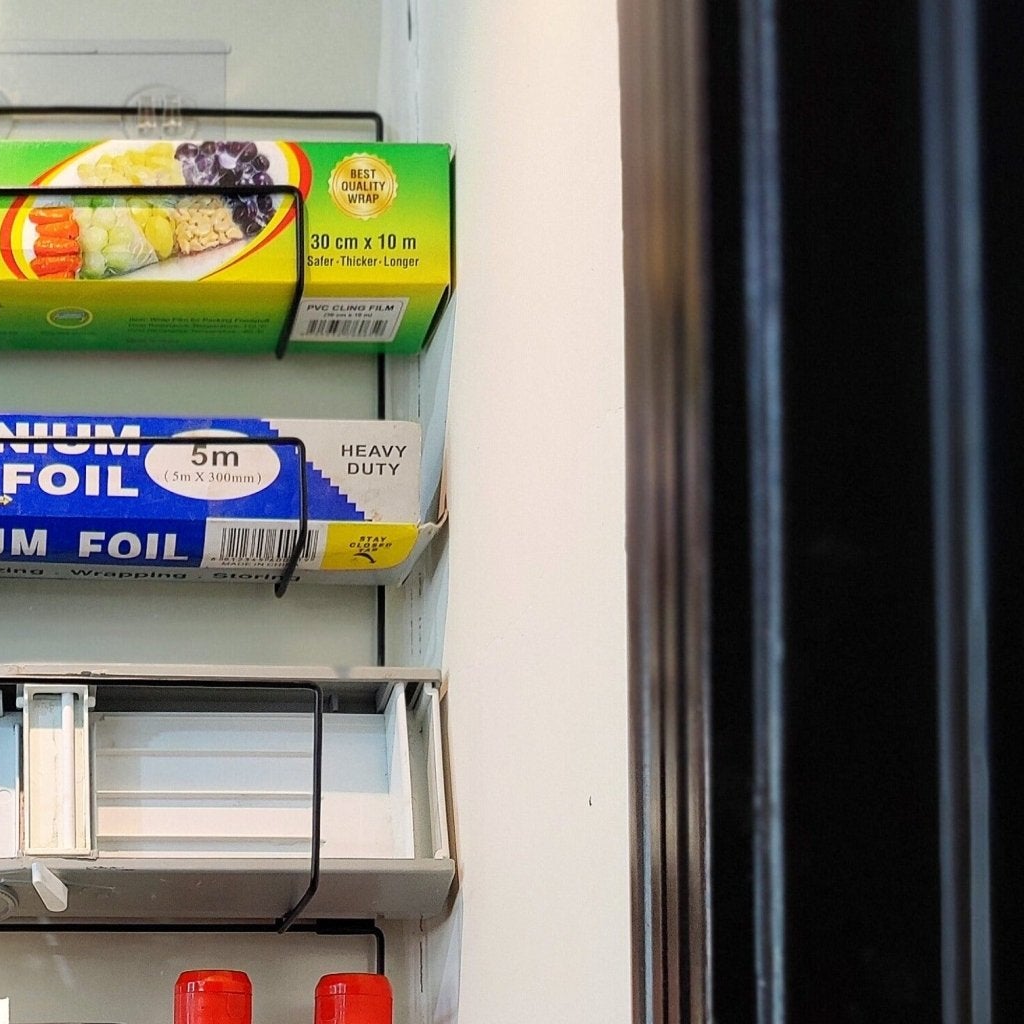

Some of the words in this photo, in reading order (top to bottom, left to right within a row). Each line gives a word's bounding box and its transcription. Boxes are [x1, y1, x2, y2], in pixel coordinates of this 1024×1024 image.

[350, 168, 376, 179] BEST
[341, 180, 386, 192] QUALITY
[347, 193, 380, 204] WRAP
[310, 233, 330, 250] 30
[335, 236, 358, 250] cm
[364, 236, 372, 250] x
[378, 233, 397, 250] 10
[402, 236, 417, 250] m
[307, 304, 329, 312] PVC
[332, 304, 366, 312] CLING
[369, 304, 395, 312] FILM
[191, 443, 239, 467] 5m
[341, 443, 407, 458] HEAVY
[347, 462, 400, 476] DUTY
[2, 463, 139, 498] FOIL
[78, 530, 189, 561] FOIL
[359, 535, 387, 543] STAY
[71, 568, 187, 580] Wrapping
